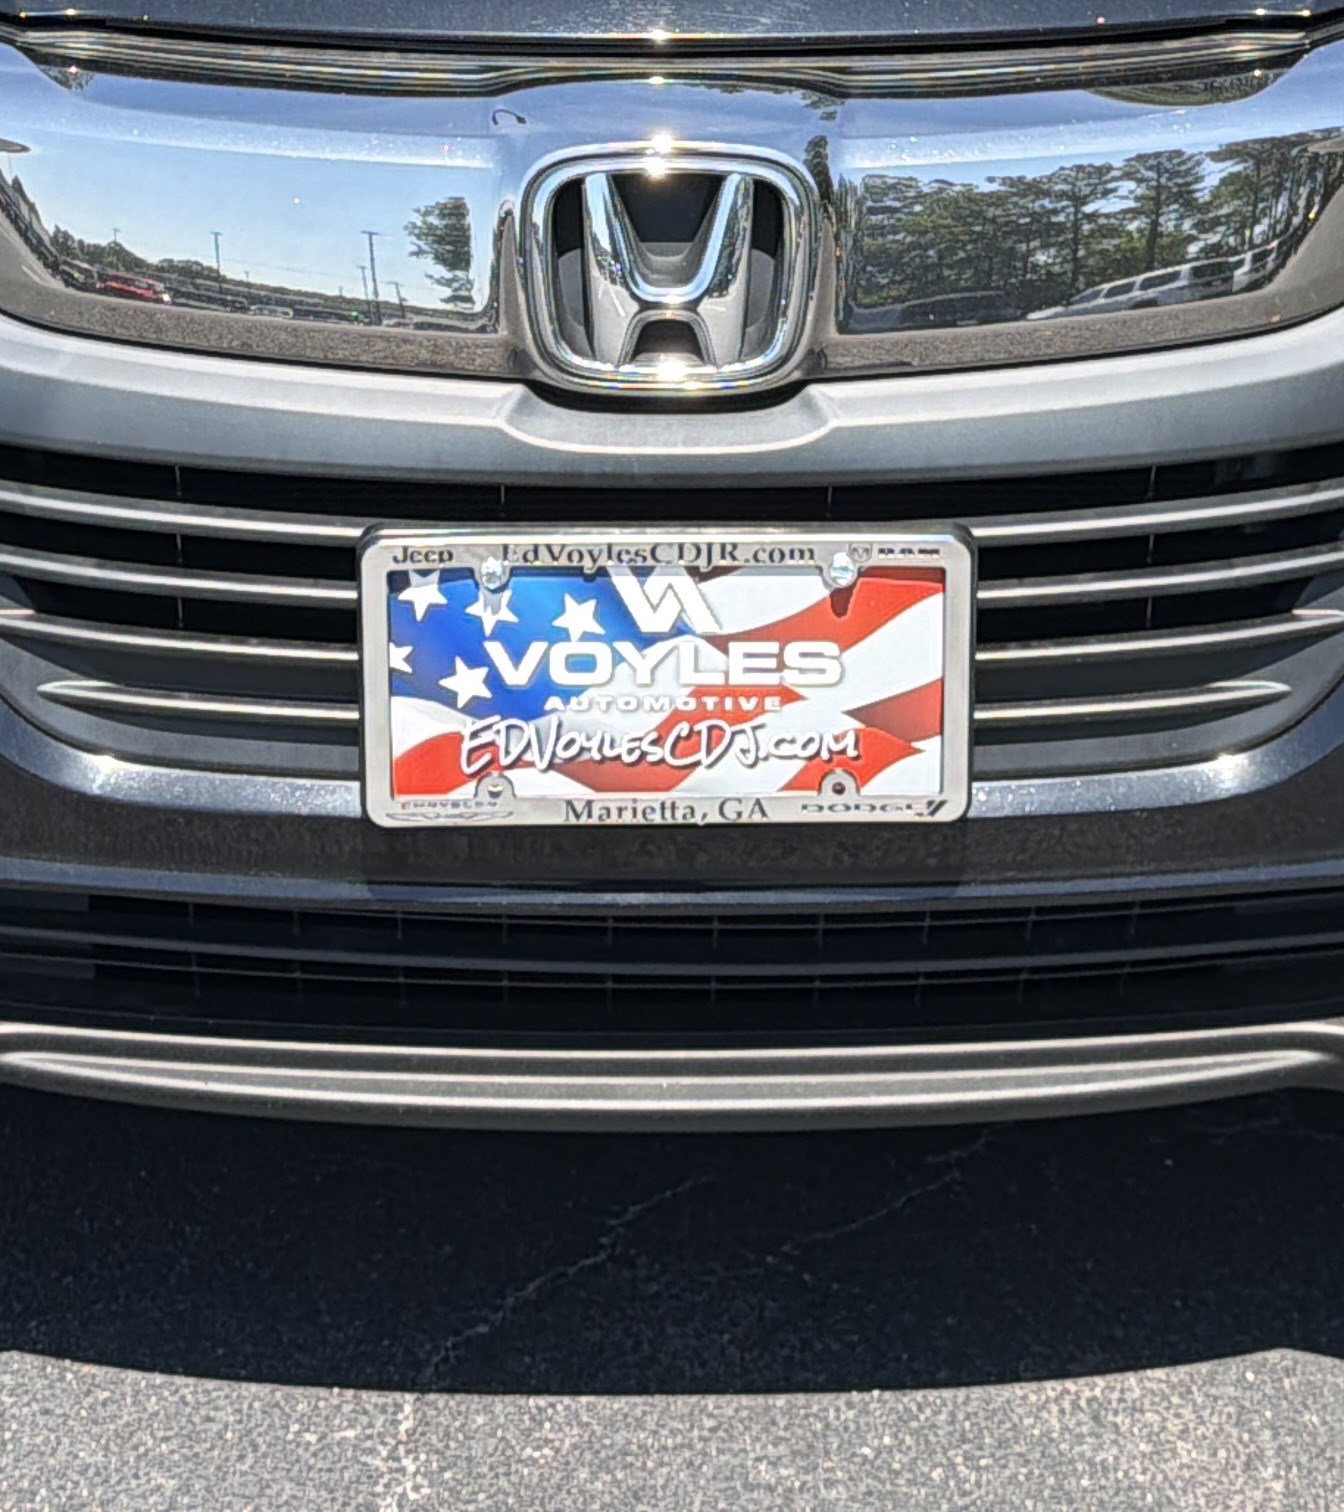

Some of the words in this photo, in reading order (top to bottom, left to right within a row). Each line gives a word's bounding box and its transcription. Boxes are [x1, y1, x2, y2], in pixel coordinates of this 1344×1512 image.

[392, 545, 454, 565] Jeep
[502, 542, 816, 571] EdVoylesCDJR.com
[481, 640, 844, 687] VOYLES
[543, 695, 784, 713] AUTOMOTIVE
[563, 797, 708, 822] Marietta,
[718, 797, 771, 822] GA
